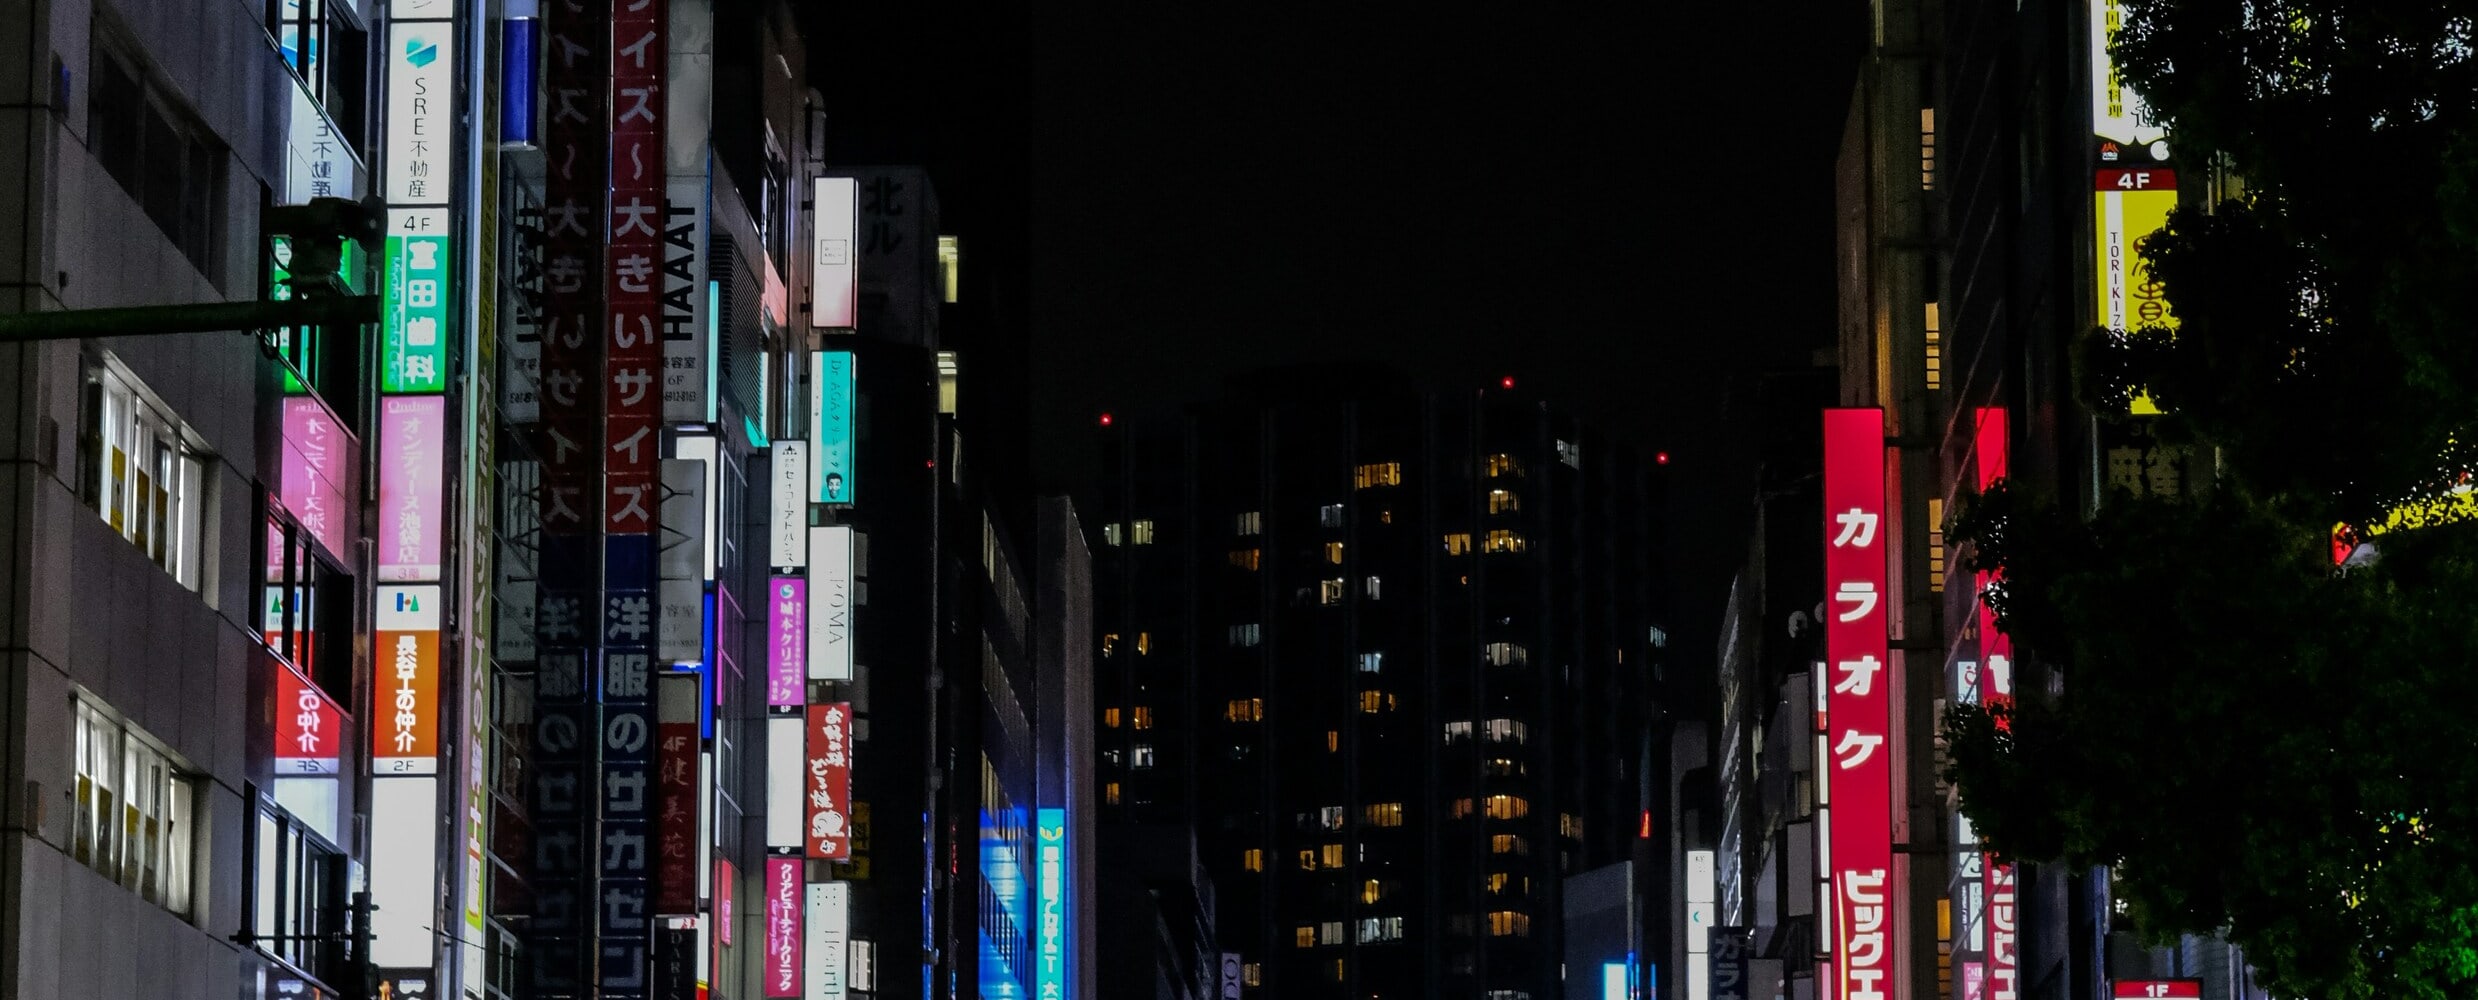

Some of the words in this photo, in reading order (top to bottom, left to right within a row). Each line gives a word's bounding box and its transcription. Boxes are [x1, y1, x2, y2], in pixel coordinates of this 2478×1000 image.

[408, 77, 428, 197] SRE不動産
[2117, 172, 2150, 189] 4F
[403, 215, 431, 232] 4F
[405, 240, 438, 384] 宮田歯科
[780, 601, 794, 701] 城本クリニック
[1833, 508, 1883, 770] カラオケ
[394, 635, 417, 752] 長谷工の仲介
[393, 760, 415, 771] 2F
[603, 597, 649, 987] 洋服のサカゼン
[2145, 984, 2169, 998] 1F
